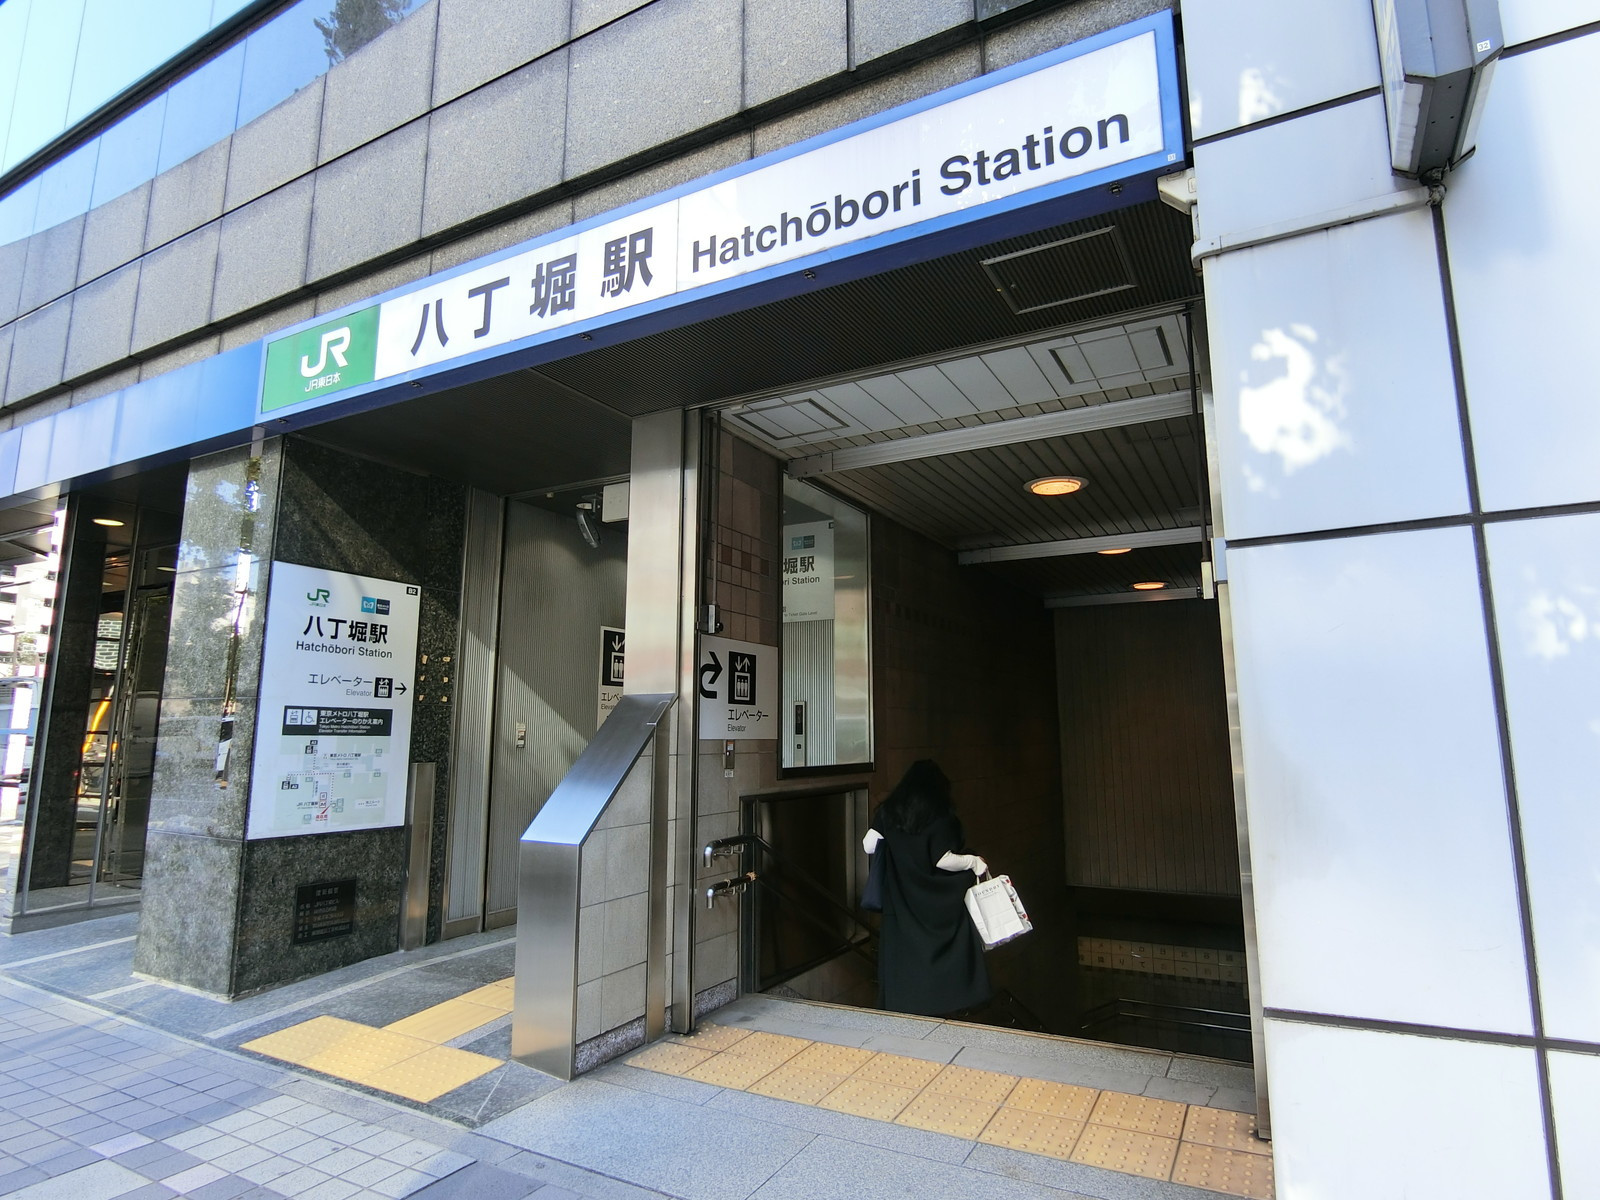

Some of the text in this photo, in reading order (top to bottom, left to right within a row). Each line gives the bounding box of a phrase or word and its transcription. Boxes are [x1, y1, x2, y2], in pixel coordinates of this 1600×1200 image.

[692, 113, 1130, 274] Hatchōbori Station
[410, 226, 654, 356] 八丁堀駅
[301, 326, 351, 378] JR
[304, 372, 341, 392] JR東日本
[792, 576, 820, 585] Station
[307, 588, 330, 603] JR
[303, 615, 388, 644] 八丁堀駅
[358, 646, 392, 658] Station
[308, 673, 373, 687] エレベーター
[601, 692, 622, 701] エレベ
[728, 709, 768, 722] エレベーター
